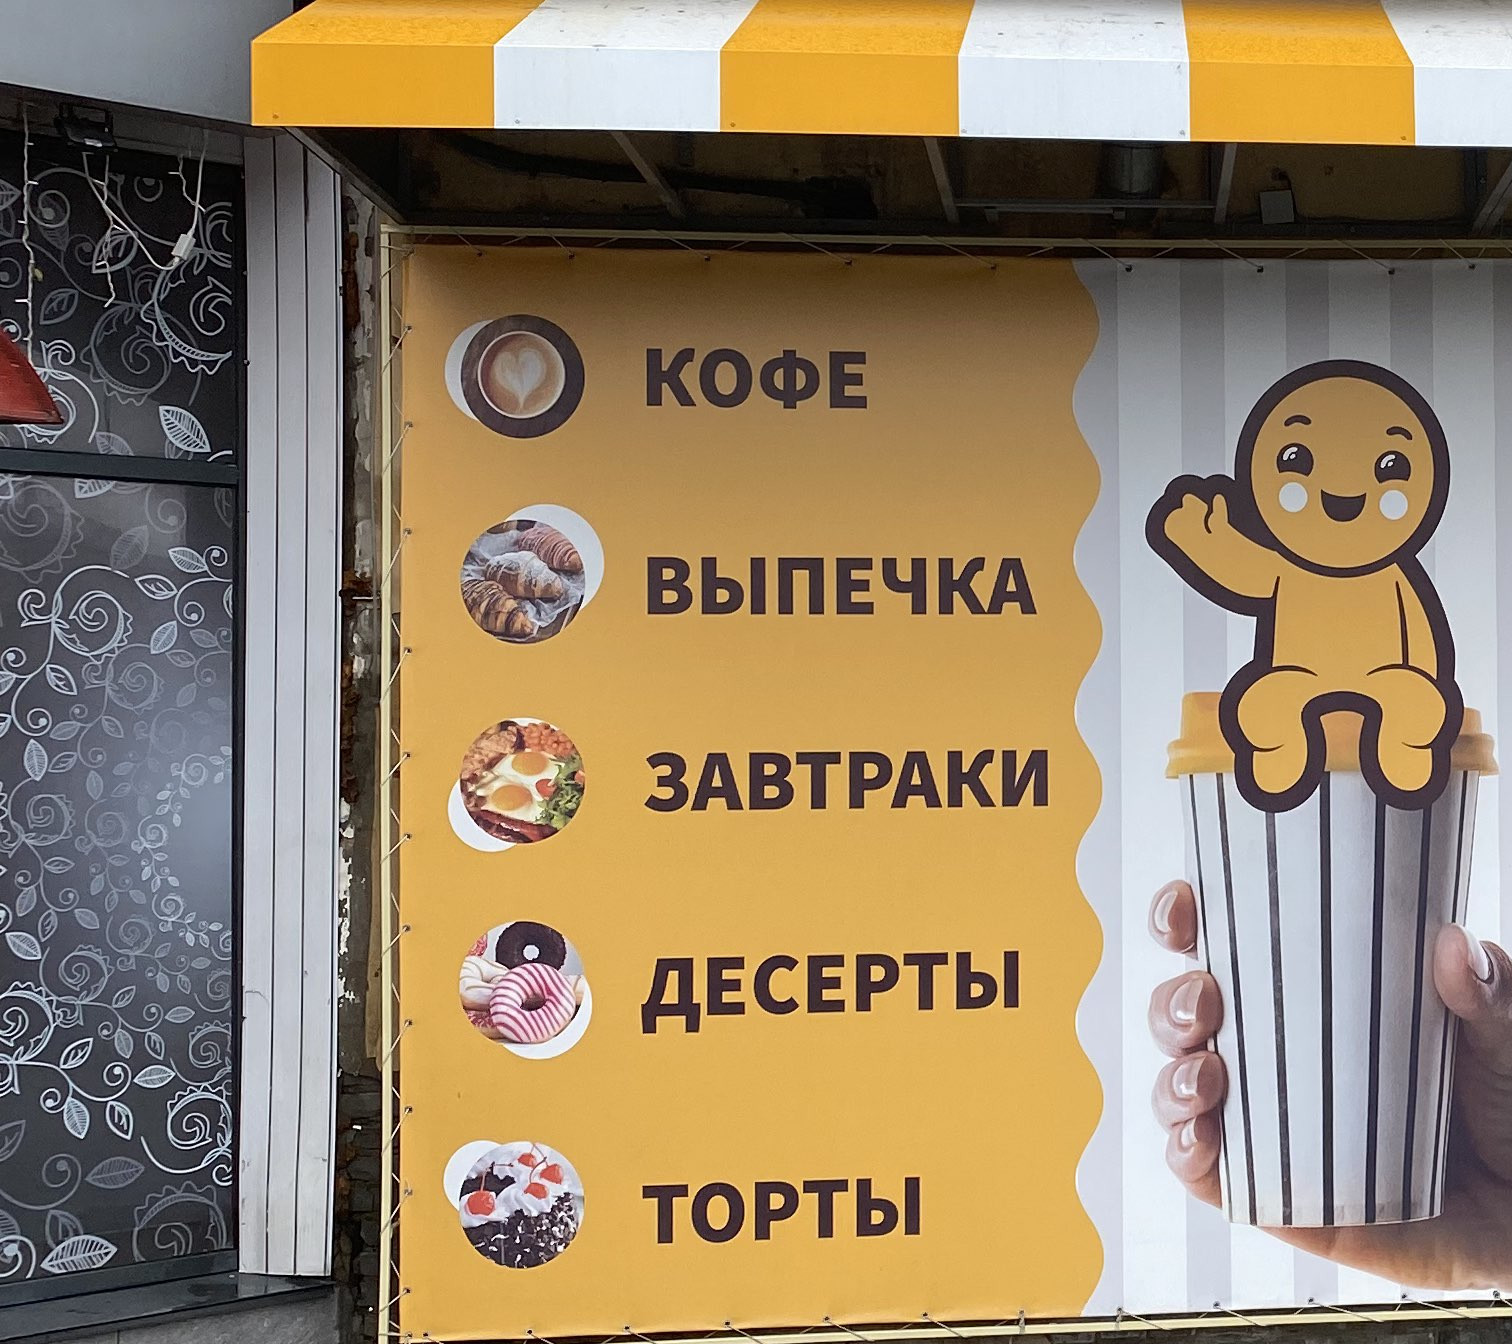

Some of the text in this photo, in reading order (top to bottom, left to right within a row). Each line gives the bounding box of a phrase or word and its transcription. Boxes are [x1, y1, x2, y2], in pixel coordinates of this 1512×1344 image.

[644, 347, 869, 410] КОФЕ
[645, 556, 1038, 616] ВЫПЕЧКА
[643, 748, 1050, 812] ЗАВТРАКИ
[640, 949, 1021, 1035] ДЕСЕРТЫ
[642, 1175, 922, 1245] ТОРТЫ
